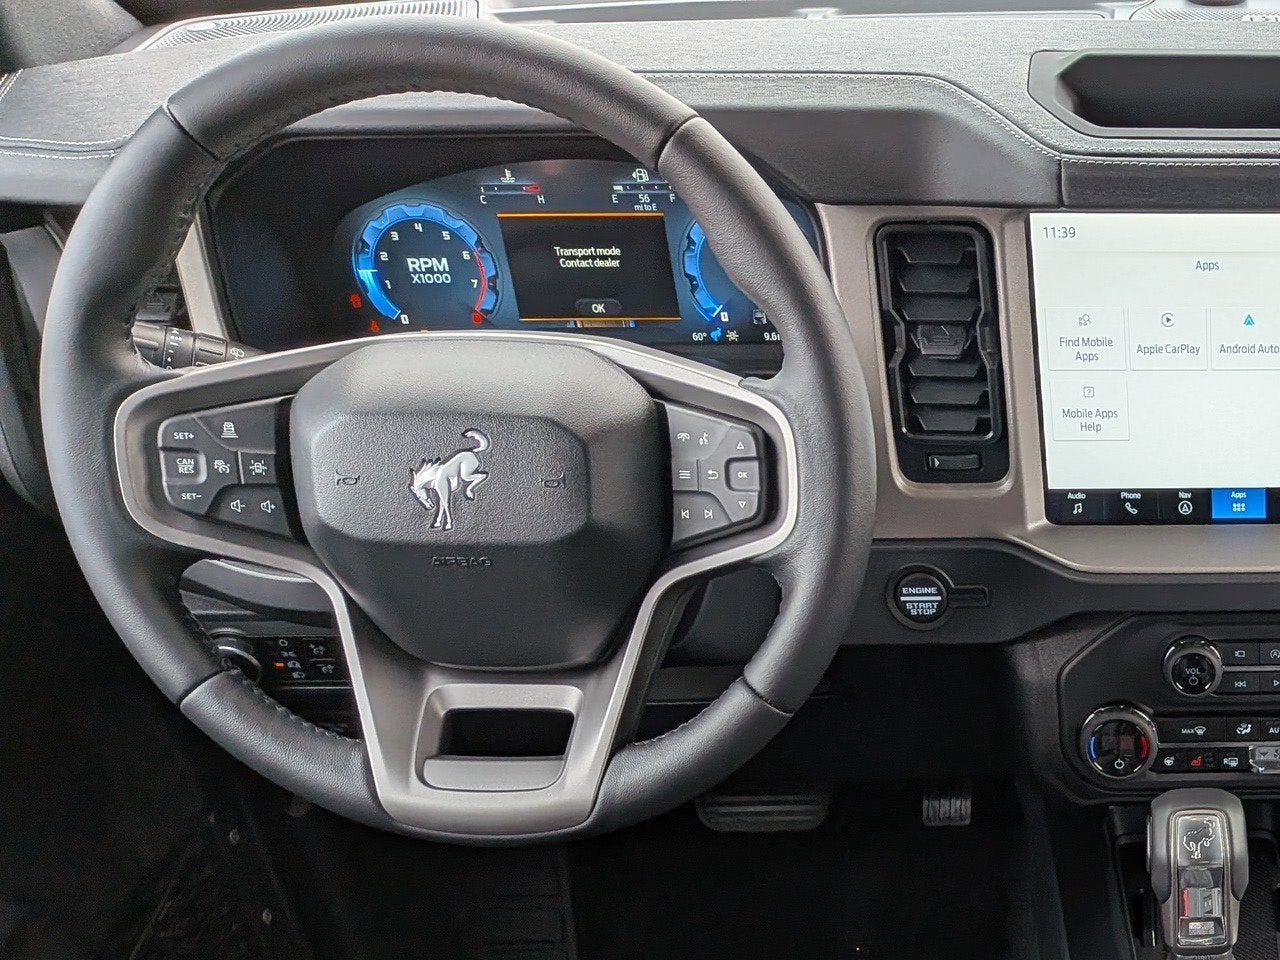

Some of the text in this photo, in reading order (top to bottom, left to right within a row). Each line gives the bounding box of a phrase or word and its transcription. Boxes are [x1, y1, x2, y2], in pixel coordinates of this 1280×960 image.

[480, 195, 486, 204] C
[537, 195, 544, 203] H
[612, 194, 618, 203] E
[638, 194, 650, 203] 56
[669, 194, 675, 202] F
[414, 223, 423, 232] 4
[390, 231, 399, 241] 3
[442, 231, 450, 240] 5
[1043, 226, 1076, 239] 11:39
[462, 251, 471, 260] 6
[553, 246, 621, 257] Transport mode
[379, 252, 389, 261] 2
[406, 257, 450, 272] RPM
[560, 257, 620, 267] Contact dealer
[1195, 260, 1220, 272] Apps
[411, 273, 451, 284] X1000
[385, 280, 391, 289] 1
[471, 279, 478, 288] 7
[591, 304, 606, 313] OK
[400, 314, 409, 324] 0
[1059, 337, 1113, 347] Find Mobile
[1136, 344, 1200, 355] Apple CarPlay
[1219, 343, 1280, 354] Android Auto
[1075, 351, 1099, 362] Apps
[1062, 408, 1118, 419] Mobile Apps
[1080, 422, 1102, 432] Help
[176, 458, 195, 466] CAN
[178, 465, 195, 474] RES
[737, 471, 748, 479] OK
[1067, 492, 1086, 500] Audio
[1121, 491, 1142, 500] Phone
[1179, 491, 1192, 499] Nav
[1231, 490, 1247, 500] Apps
